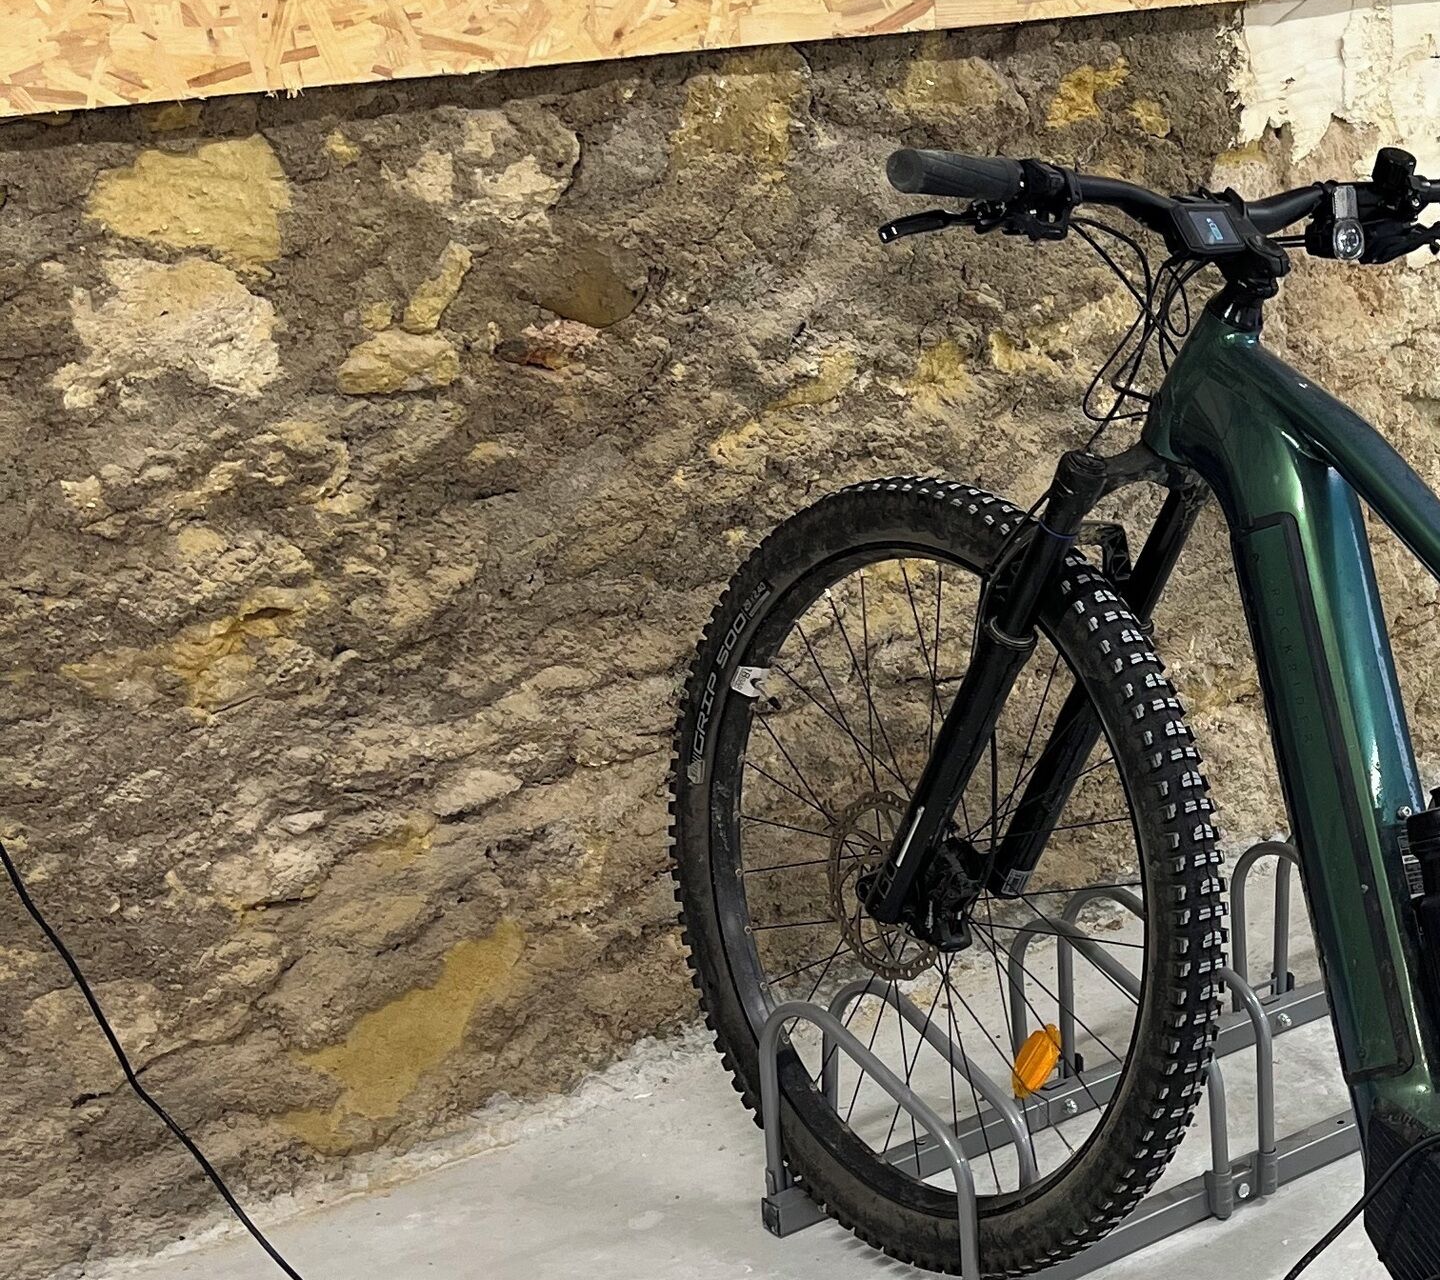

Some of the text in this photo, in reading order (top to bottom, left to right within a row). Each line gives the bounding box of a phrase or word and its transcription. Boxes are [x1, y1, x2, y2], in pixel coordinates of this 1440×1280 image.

[693, 671, 717, 759] GRIP
[716, 613, 746, 669] 500
[1271, 588, 1313, 744] ROCKRIDER
